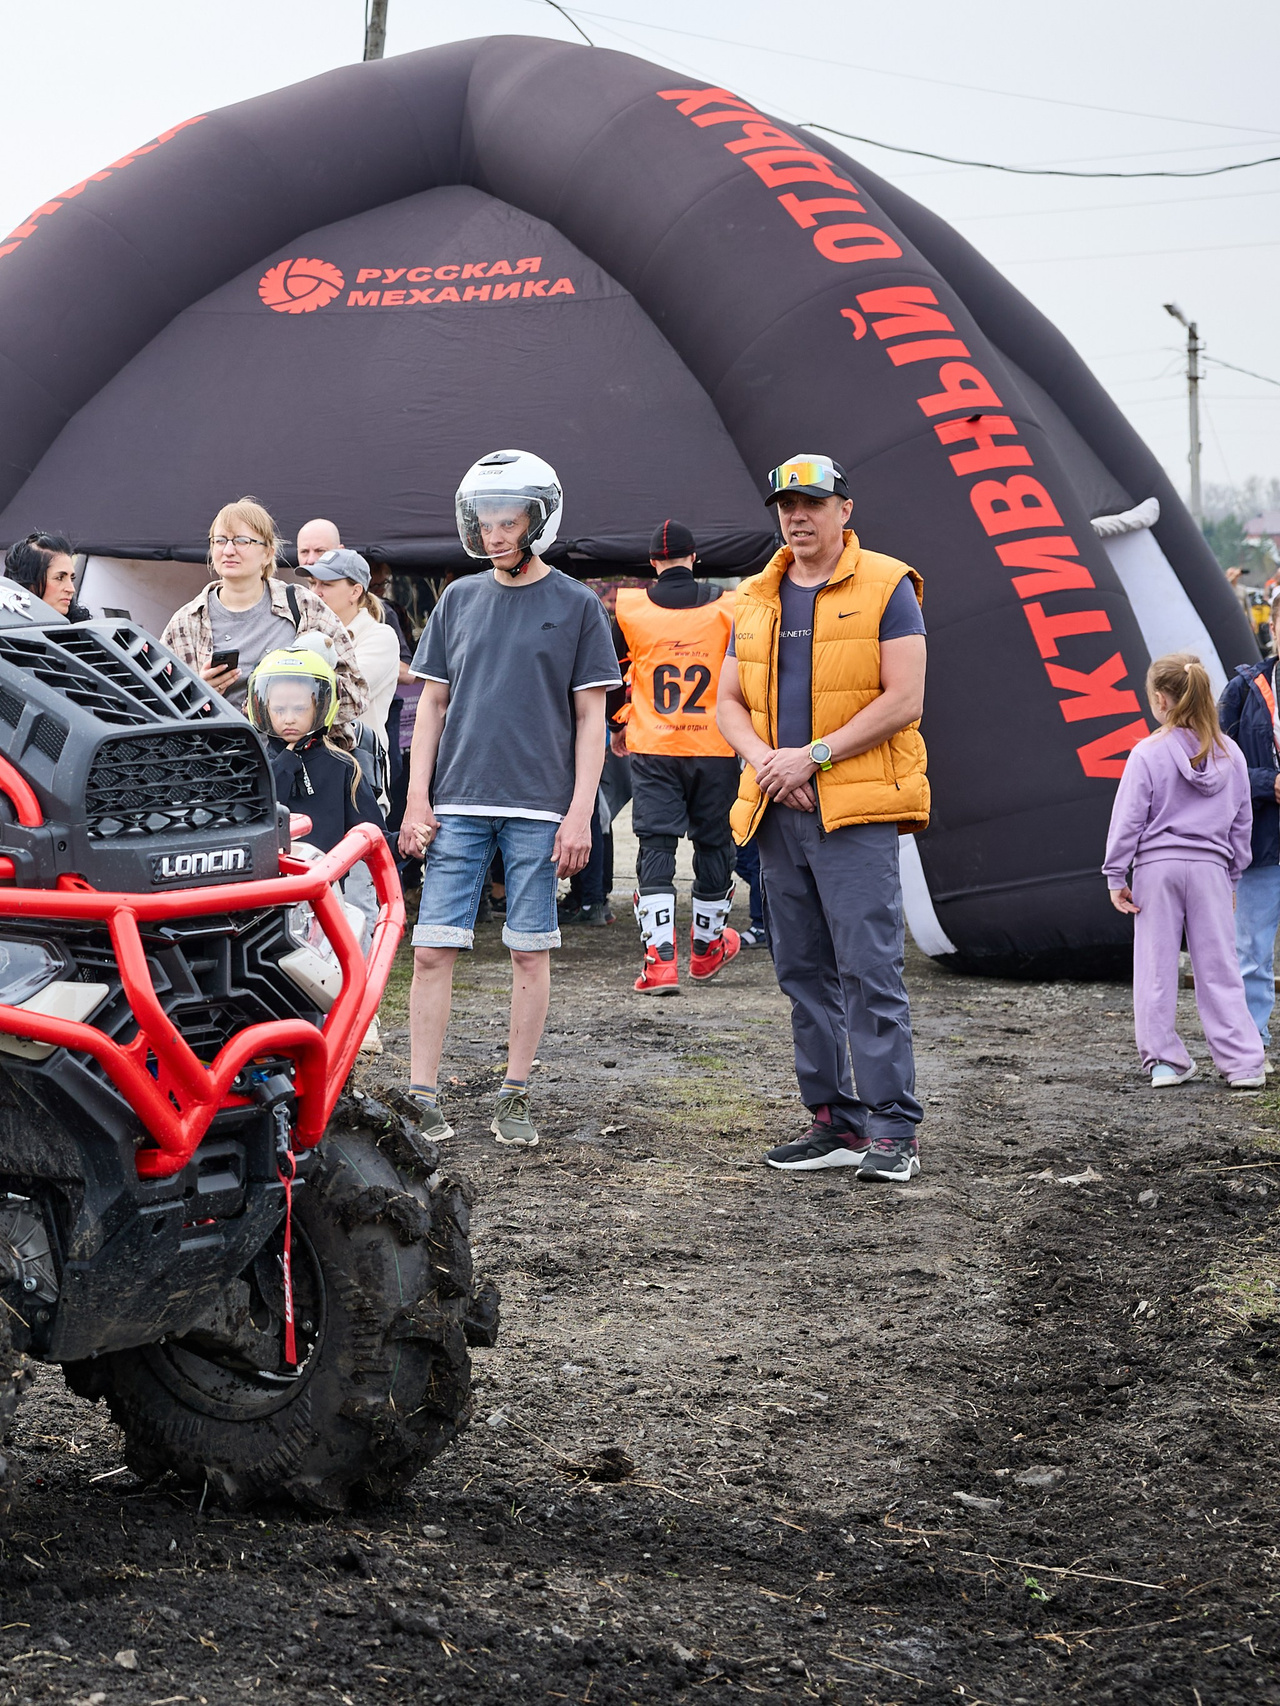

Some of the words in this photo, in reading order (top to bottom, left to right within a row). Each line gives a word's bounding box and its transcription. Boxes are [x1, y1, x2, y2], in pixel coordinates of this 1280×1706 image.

[656, 87, 903, 264] ОТДЫХ
[355, 256, 543, 284] РУССКАЯ
[345, 277, 576, 307] МЕХАНИКА
[840, 286, 1151, 780] АКТИВНЫЙ
[652, 663, 712, 715] 62
[161, 848, 245, 878] LONCIN
[655, 908, 670, 927] G
[695, 912, 711, 930] G
